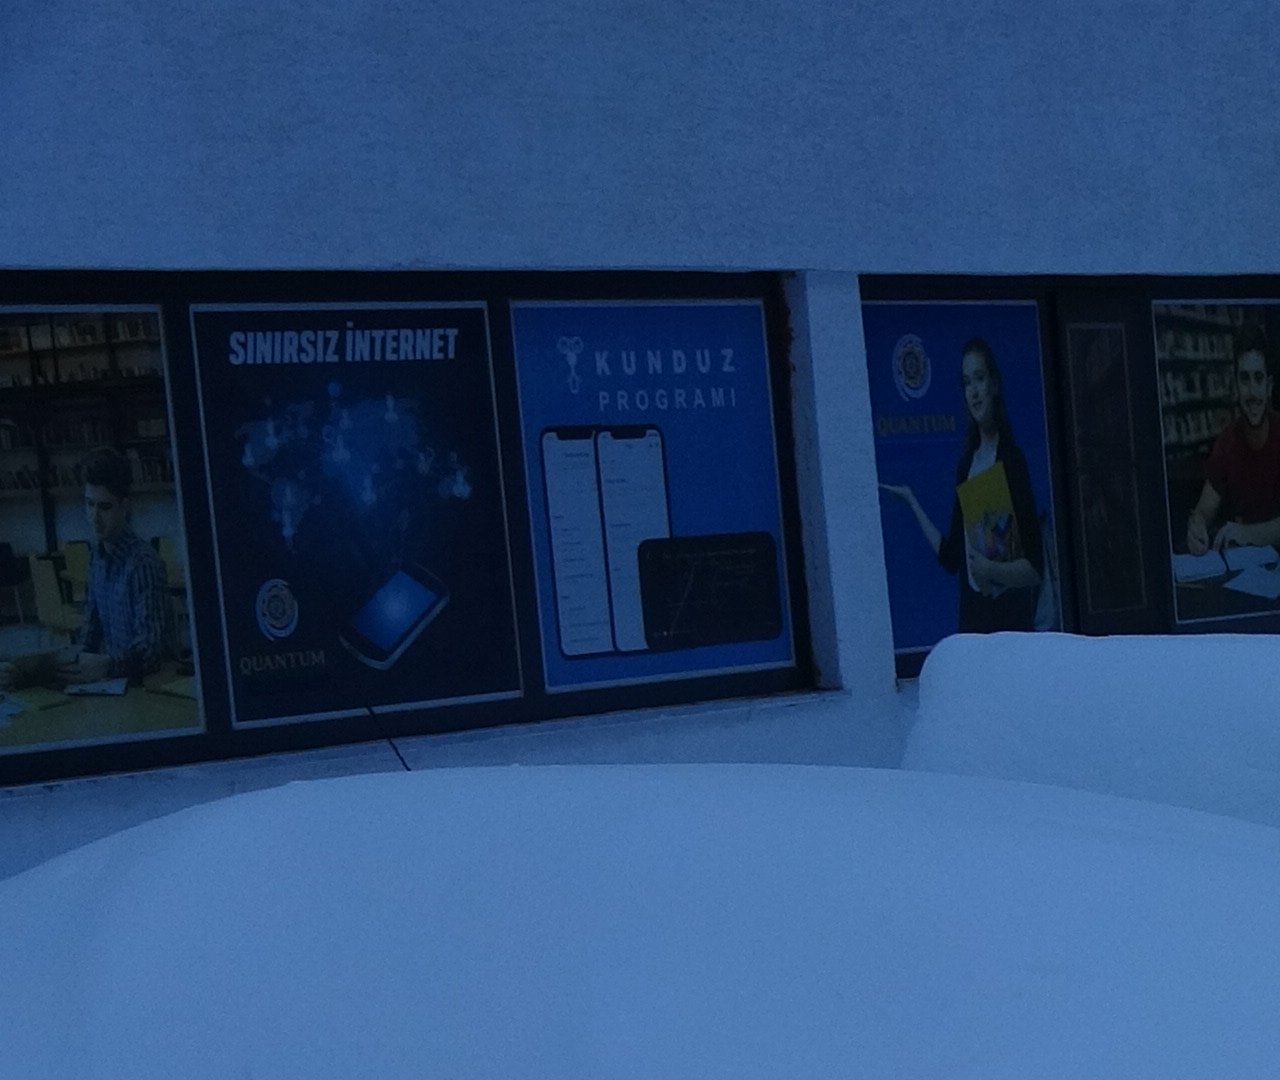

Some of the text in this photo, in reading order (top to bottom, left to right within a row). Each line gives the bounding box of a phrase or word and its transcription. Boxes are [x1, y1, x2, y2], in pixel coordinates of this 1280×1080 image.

[228, 320, 460, 366] SINIRSIZ İNTERNET
[594, 348, 736, 376] KUNDUZ
[599, 386, 736, 412] PROGRAMI
[239, 649, 326, 676] QUANTUM
